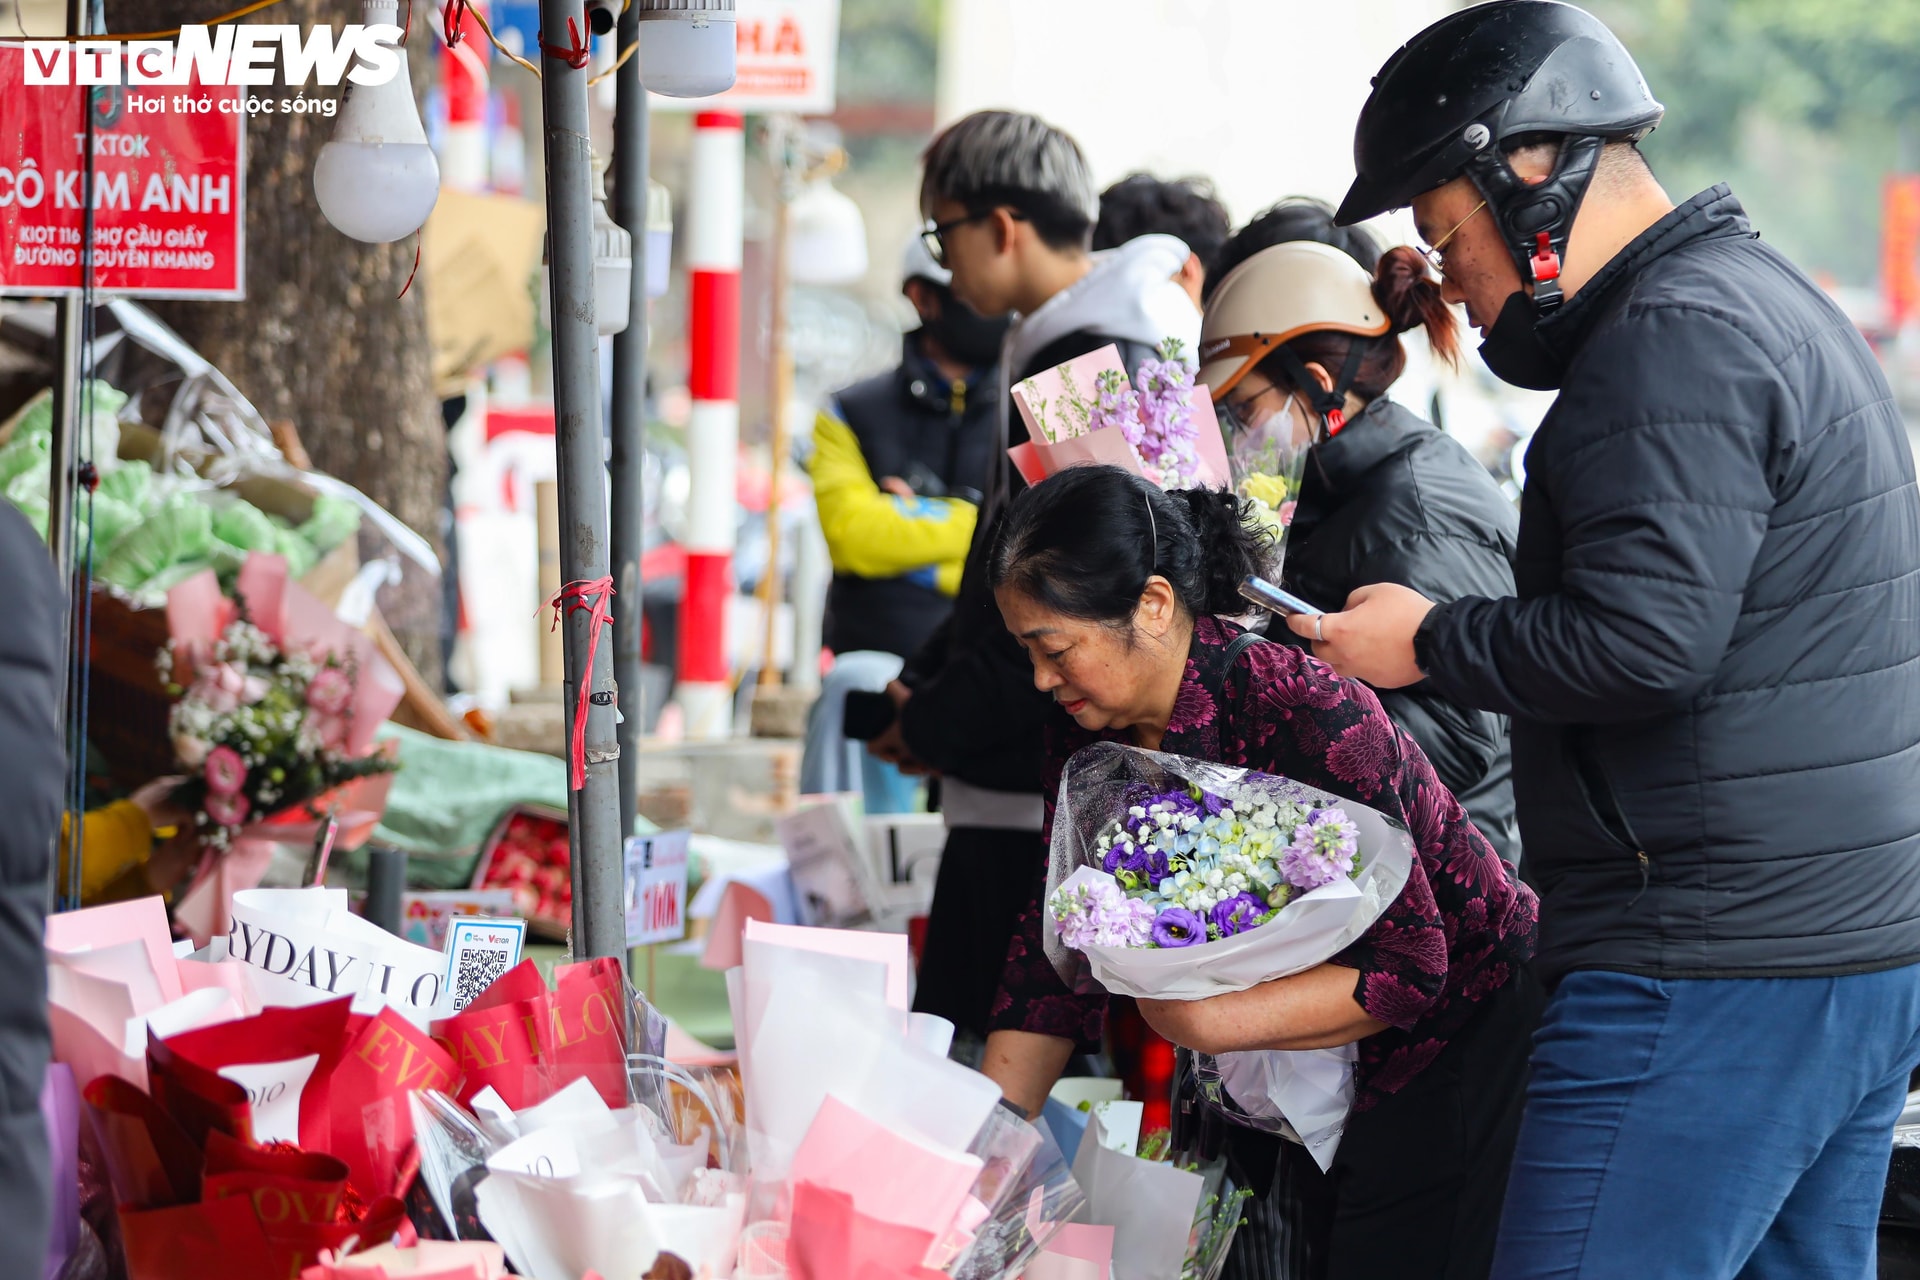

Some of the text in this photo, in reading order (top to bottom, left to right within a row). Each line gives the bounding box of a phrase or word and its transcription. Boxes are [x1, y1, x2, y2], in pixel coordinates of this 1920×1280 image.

[73, 133, 150, 157] TKTOK
[0, 157, 44, 208] CÔ
[139, 172, 230, 214] ANH
[19, 226, 56, 243] KIOT
[58, 226, 81, 244] 116
[152, 250, 214, 270] KHANG
